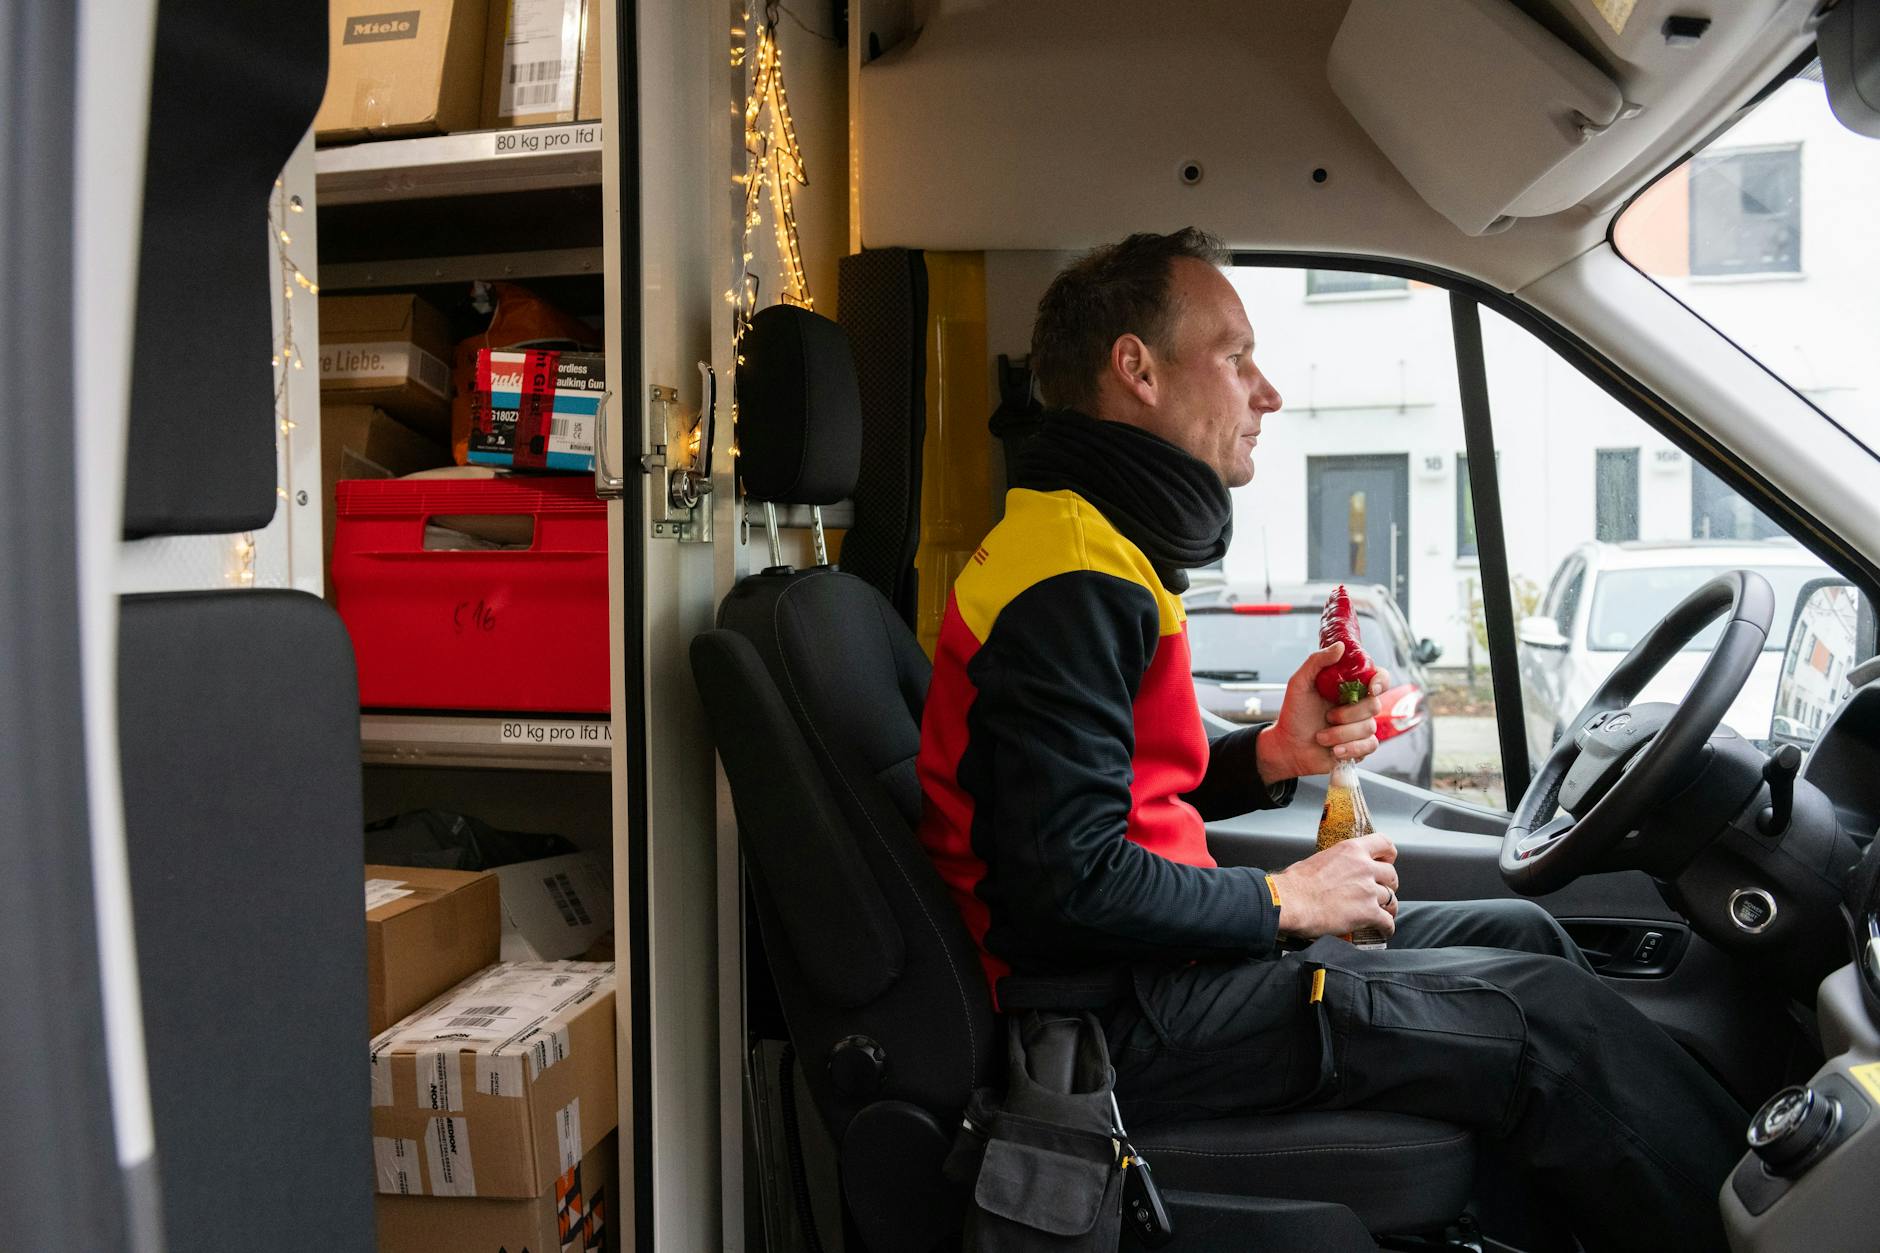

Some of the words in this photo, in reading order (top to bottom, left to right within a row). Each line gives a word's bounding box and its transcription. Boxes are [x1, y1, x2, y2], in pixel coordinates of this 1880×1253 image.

[352, 19, 411, 36] Miele
[497, 136, 516, 151] 80
[520, 133, 539, 150] kg
[544, 132, 570, 148] pro
[575, 128, 594, 143] lfd
[336, 349, 385, 371] Liebe.
[587, 379, 605, 390] Gun
[503, 724, 522, 739] 80
[526, 723, 545, 742] kg
[549, 727, 575, 743] pro
[580, 725, 598, 740] lfd
